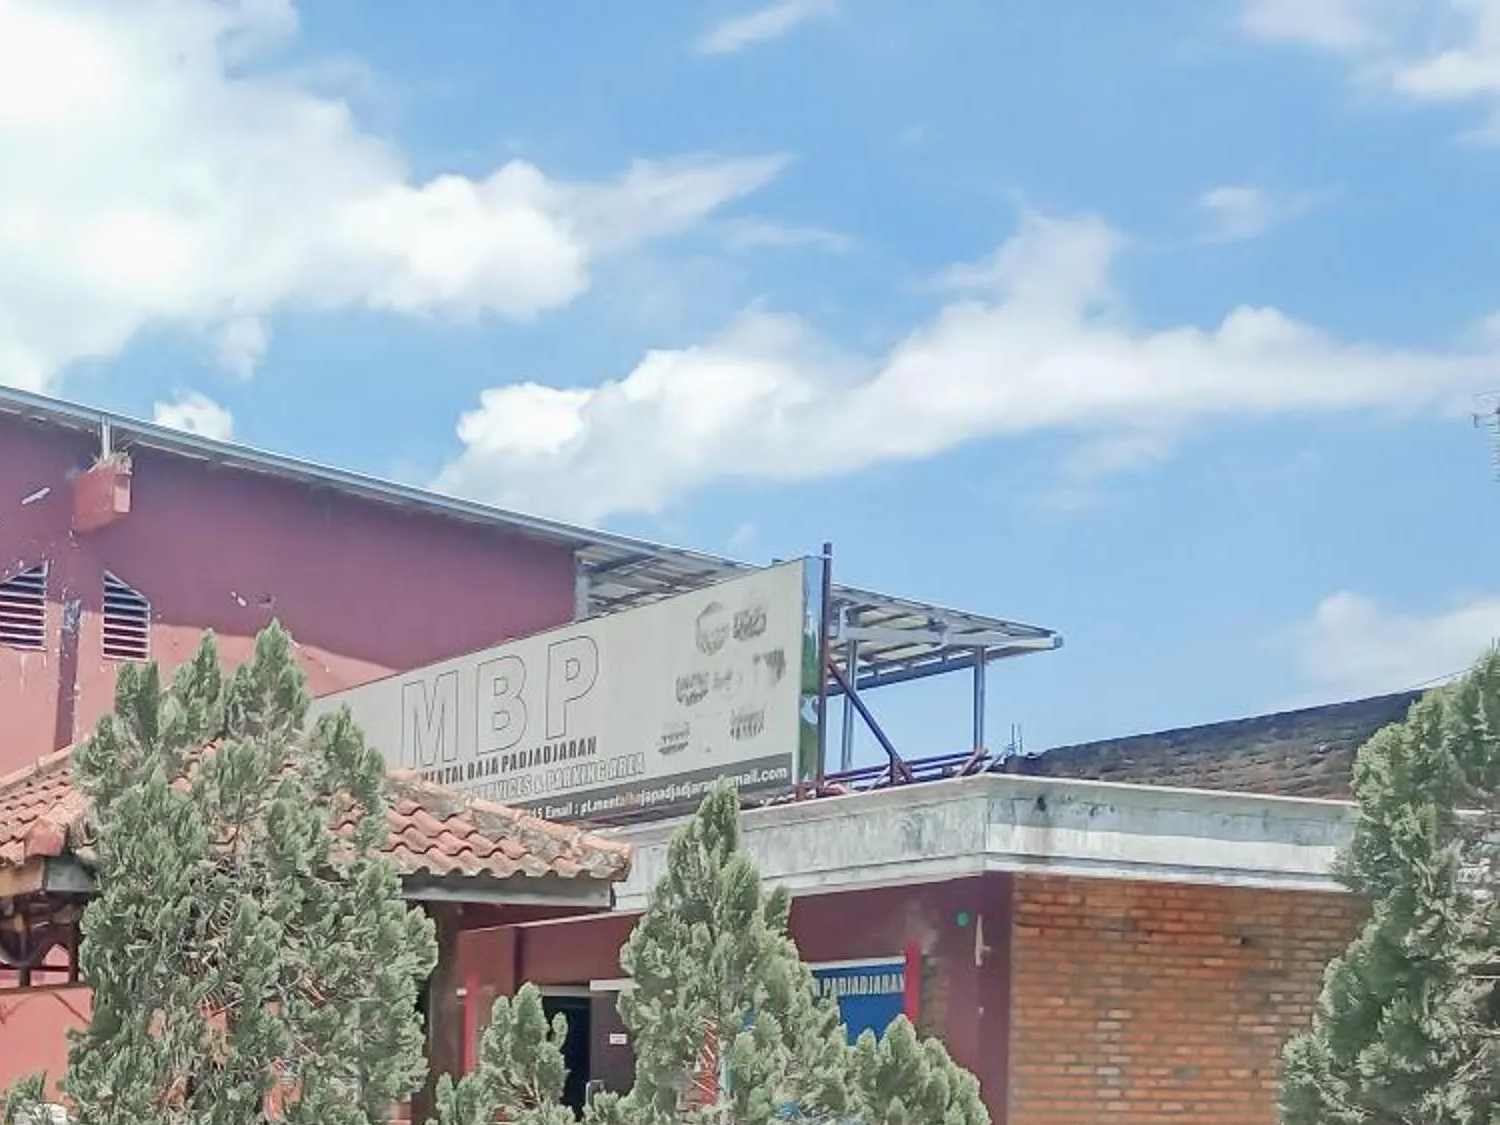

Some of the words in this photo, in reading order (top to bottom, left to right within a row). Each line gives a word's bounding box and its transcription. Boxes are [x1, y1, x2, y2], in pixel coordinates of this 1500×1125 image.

[401, 634, 599, 771] MBP
[501, 736, 597, 773] PADJADJARAN
[547, 802, 573, 819] Email
